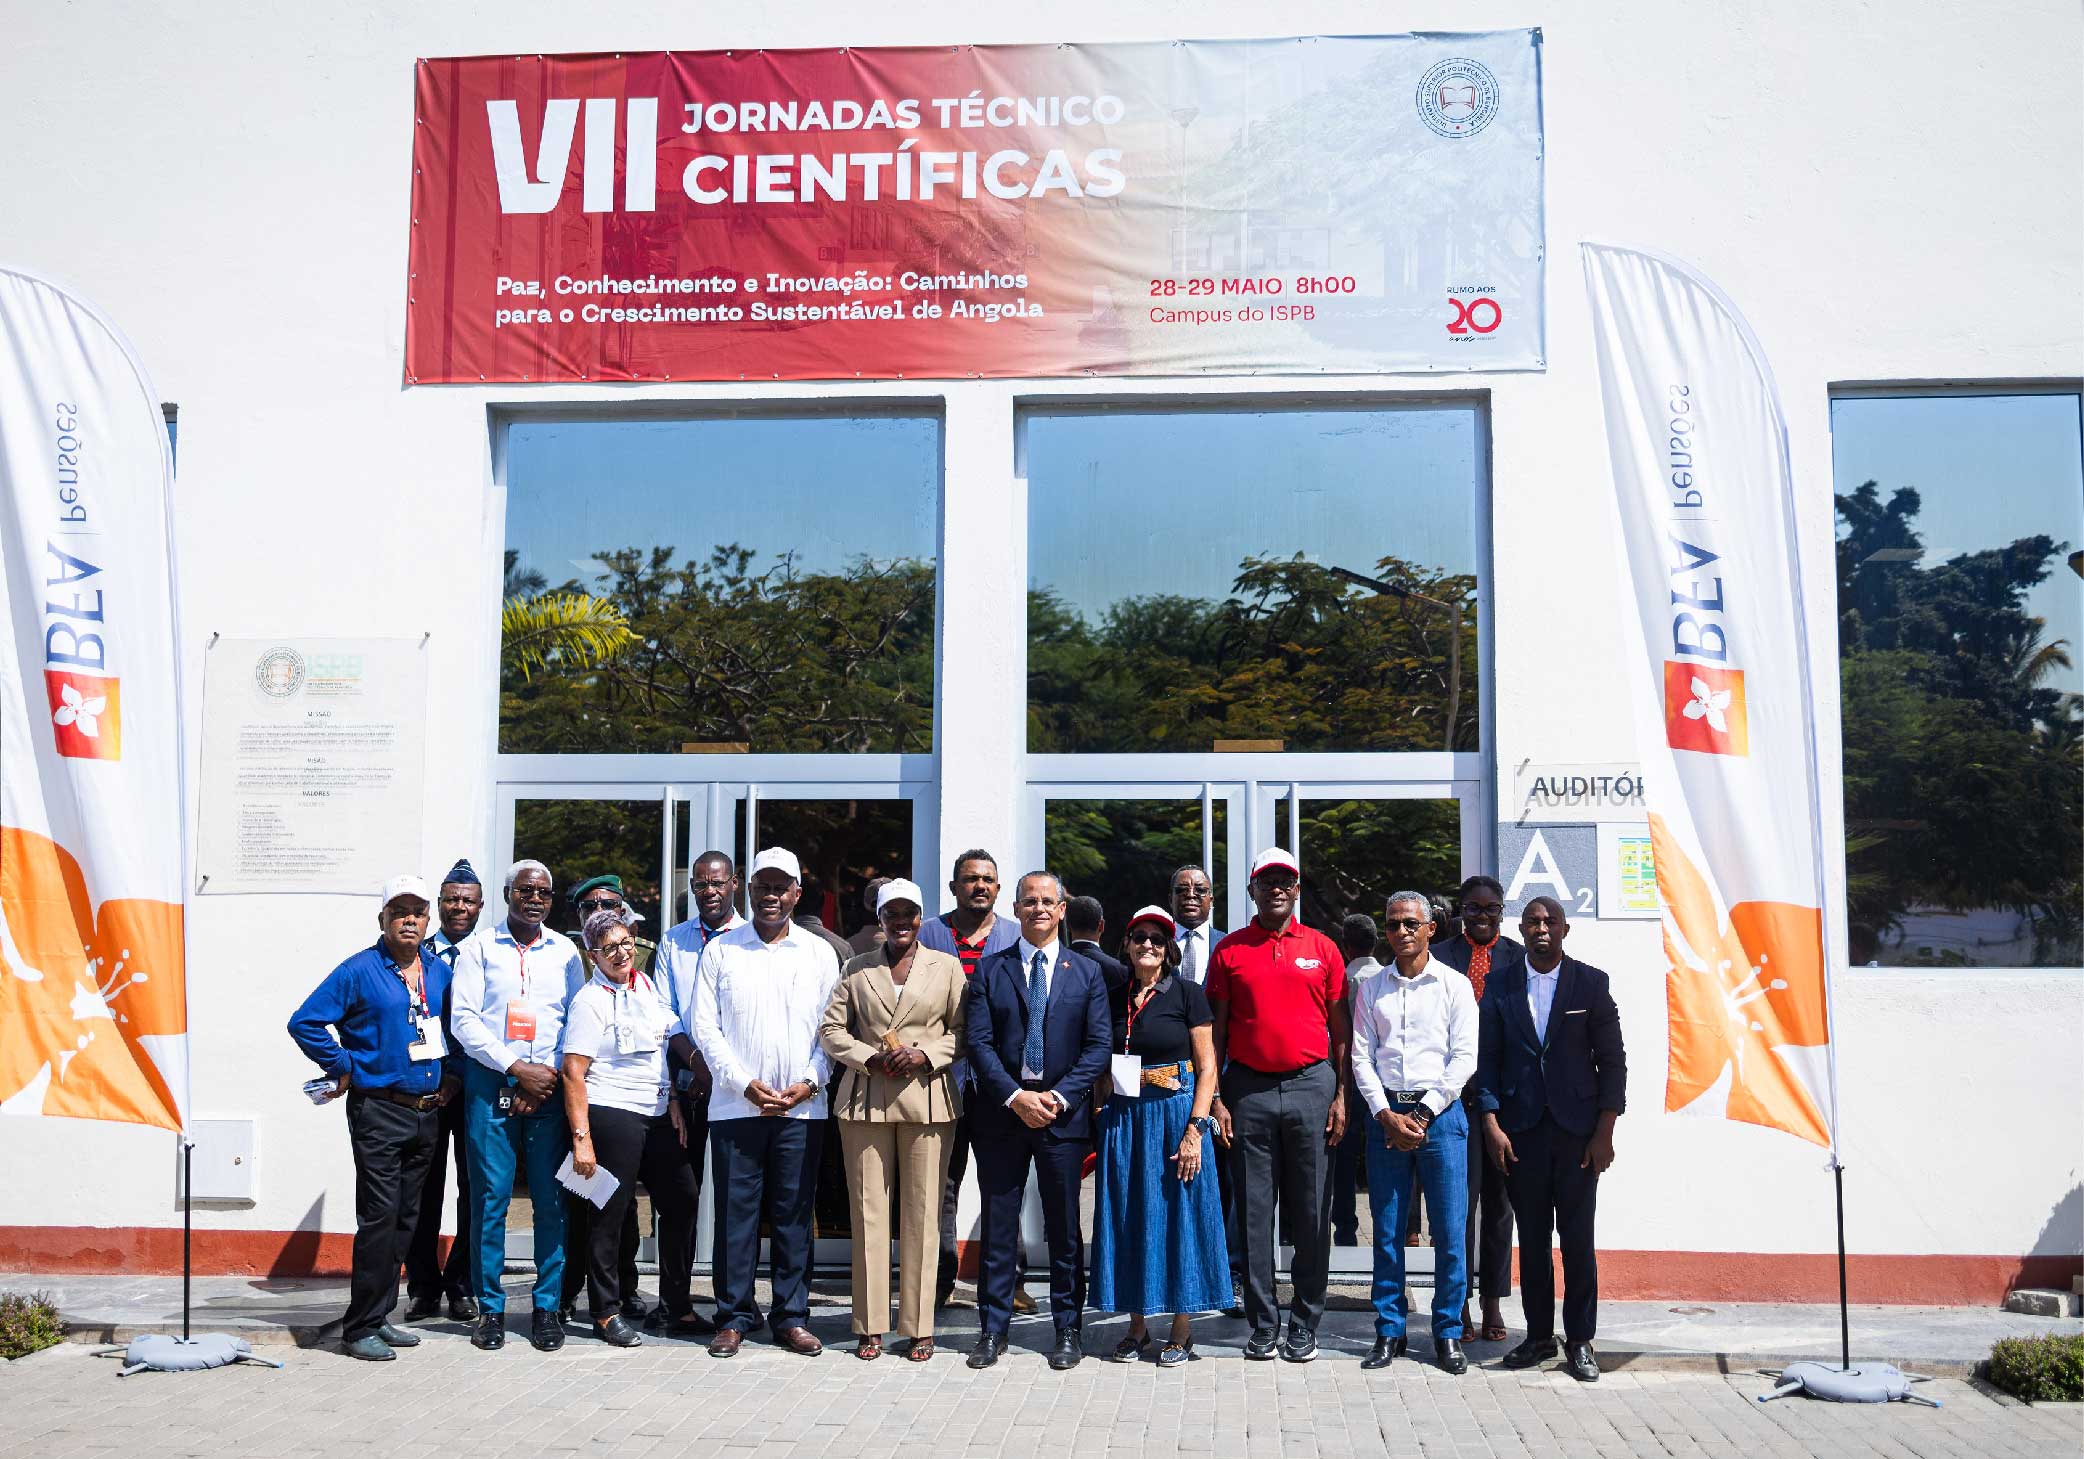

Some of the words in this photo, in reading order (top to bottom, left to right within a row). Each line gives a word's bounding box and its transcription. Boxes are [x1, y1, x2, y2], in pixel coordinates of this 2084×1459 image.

[682, 98, 921, 134] JORNADAS
[932, 90, 1125, 129] TÉCNICO
[486, 97, 659, 214] VII
[682, 138, 1127, 205] CIENTÍFICAS
[496, 276, 546, 299] Paz,
[554, 274, 737, 295] Conhecimento
[744, 277, 759, 293] e
[766, 270, 893, 296] Inovação:
[899, 270, 1028, 290] Caminhos
[1150, 278, 1215, 297] 28-29
[1221, 277, 1283, 296] MAIO
[1296, 276, 1356, 294] 8h00
[1446, 286, 1475, 294] RUMO
[1477, 286, 1496, 294] AOS
[496, 307, 552, 328] para
[559, 309, 575, 323] o
[581, 303, 744, 323] Crescimento
[750, 299, 906, 321] Sustentável
[912, 299, 943, 320] de
[949, 298, 1044, 323] Angola
[1150, 307, 1232, 325] Campus
[1238, 306, 1264, 322] do
[1270, 305, 1316, 321] ISPB
[1446, 297, 1502, 334] 20
